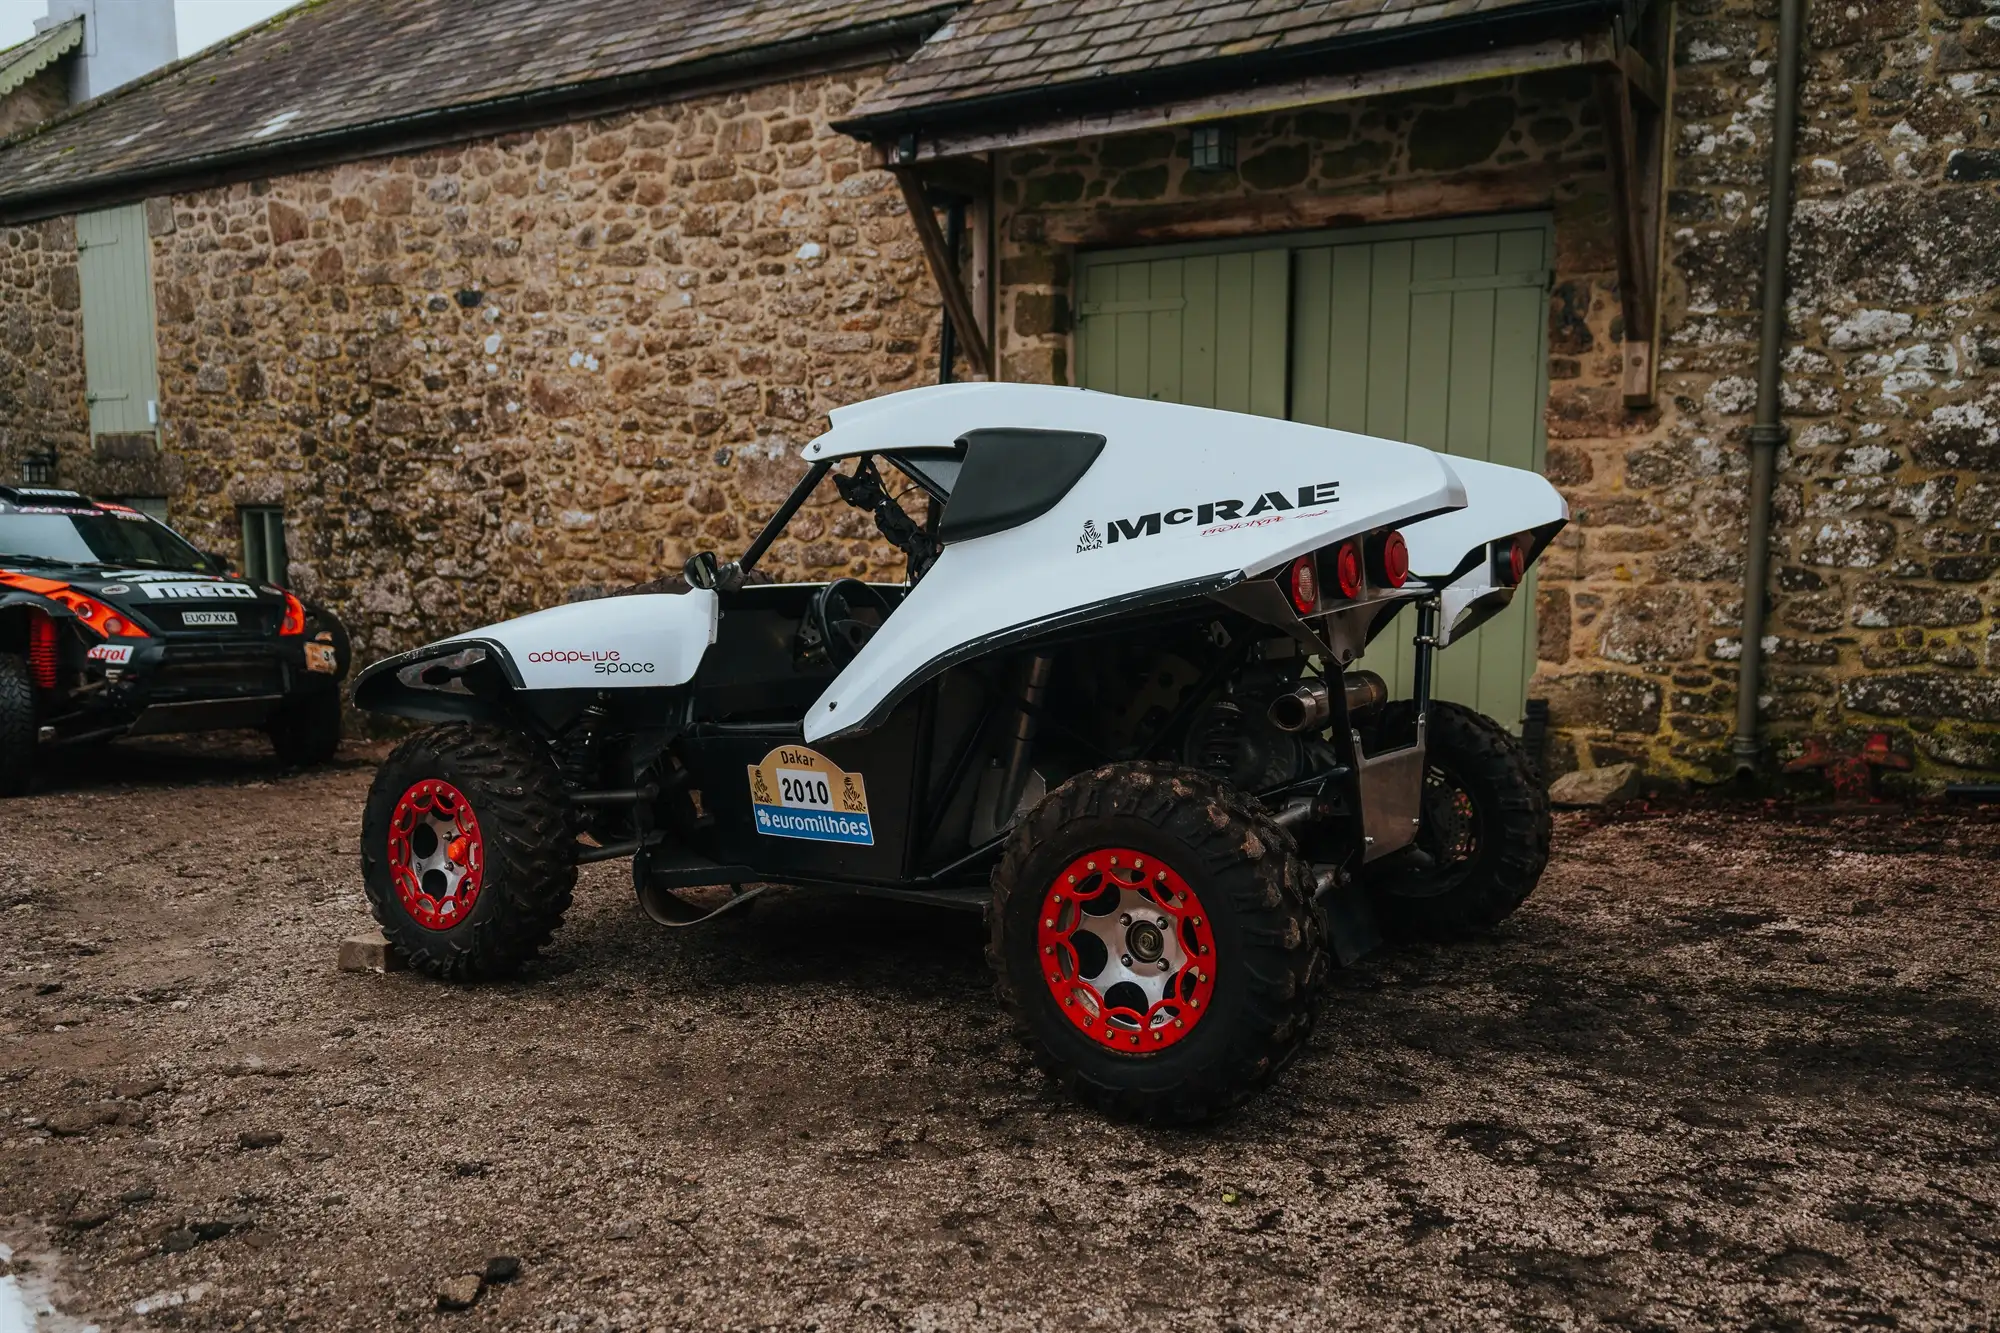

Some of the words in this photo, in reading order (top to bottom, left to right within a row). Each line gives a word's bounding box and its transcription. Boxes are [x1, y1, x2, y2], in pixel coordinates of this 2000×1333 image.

[184, 613, 211, 623] EU07
[213, 613, 236, 623] XKA
[528, 650, 620, 664] adaptive
[594, 662, 655, 675] space
[780, 750, 814, 767] Dakar
[782, 778, 829, 805] 2010
[772, 815, 868, 836] euromilhões
